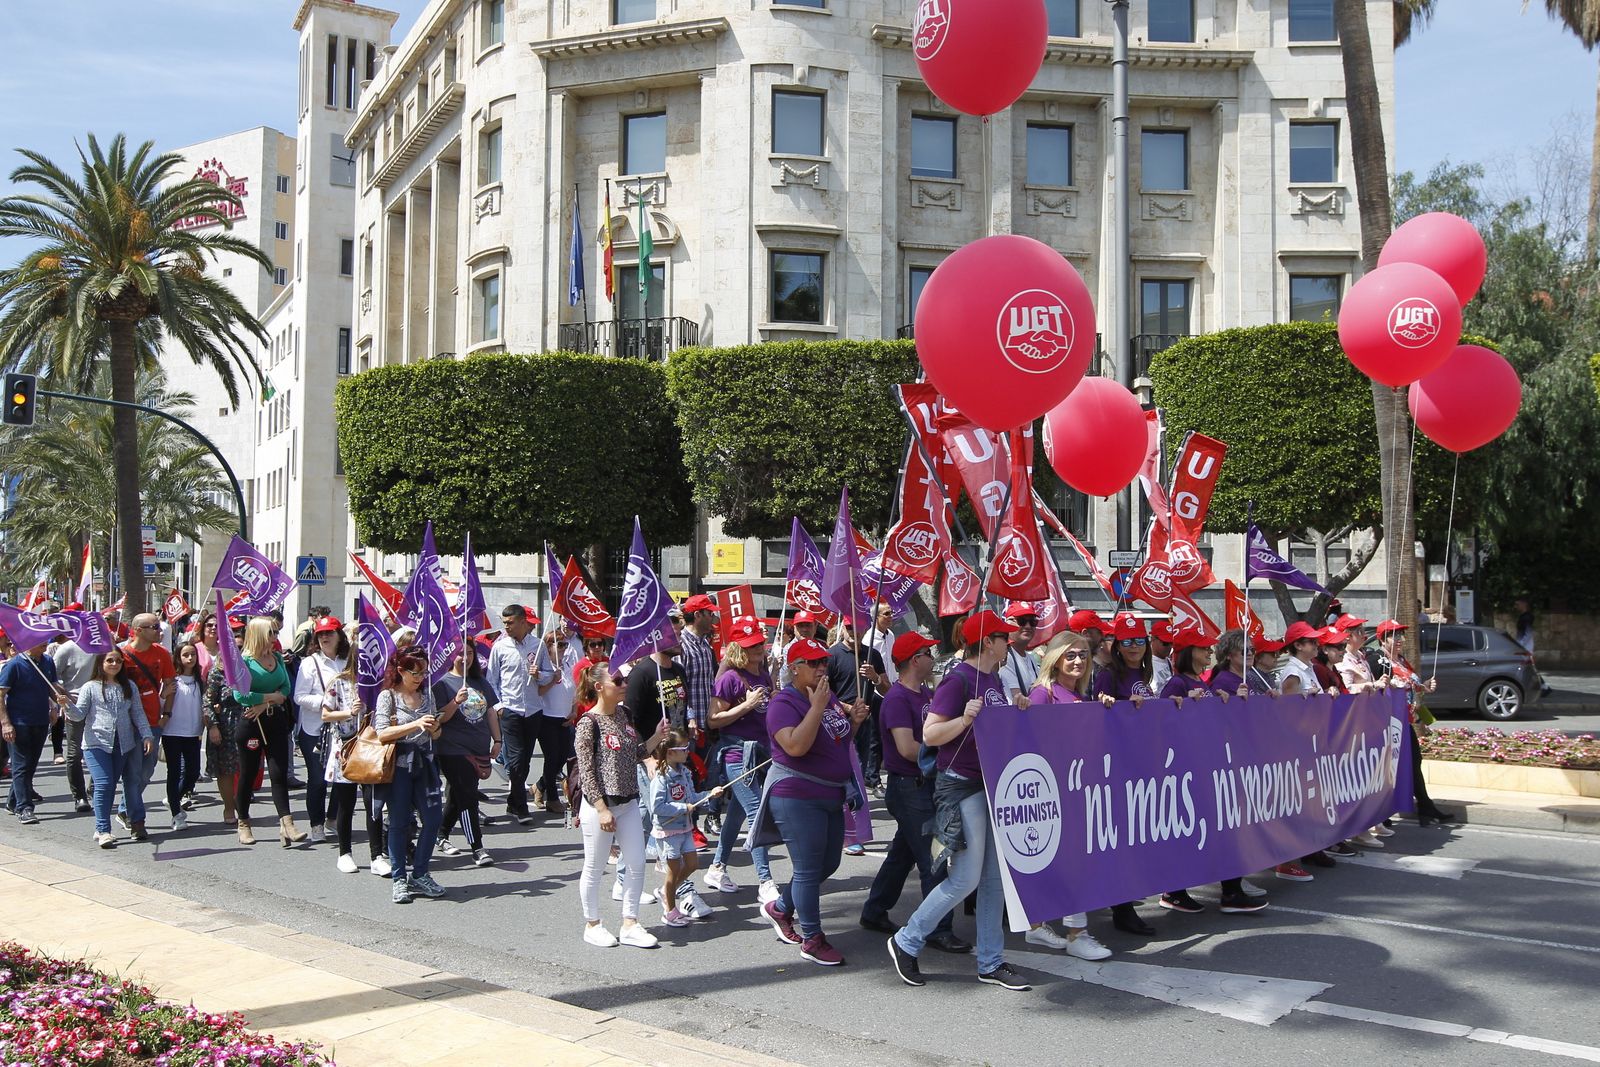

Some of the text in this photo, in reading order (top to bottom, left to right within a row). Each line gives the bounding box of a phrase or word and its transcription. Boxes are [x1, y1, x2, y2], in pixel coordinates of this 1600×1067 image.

[1009, 305, 1063, 336] UGT
[1396, 307, 1434, 326] UGT
[903, 528, 938, 551] UGT
[237, 560, 268, 592] UGT
[1017, 782, 1040, 800] UGT
[1125, 747, 1207, 851] más,
[1212, 742, 1241, 831] ni
[1239, 758, 1303, 825] menos
[996, 801, 1060, 828] FEMINISTA
